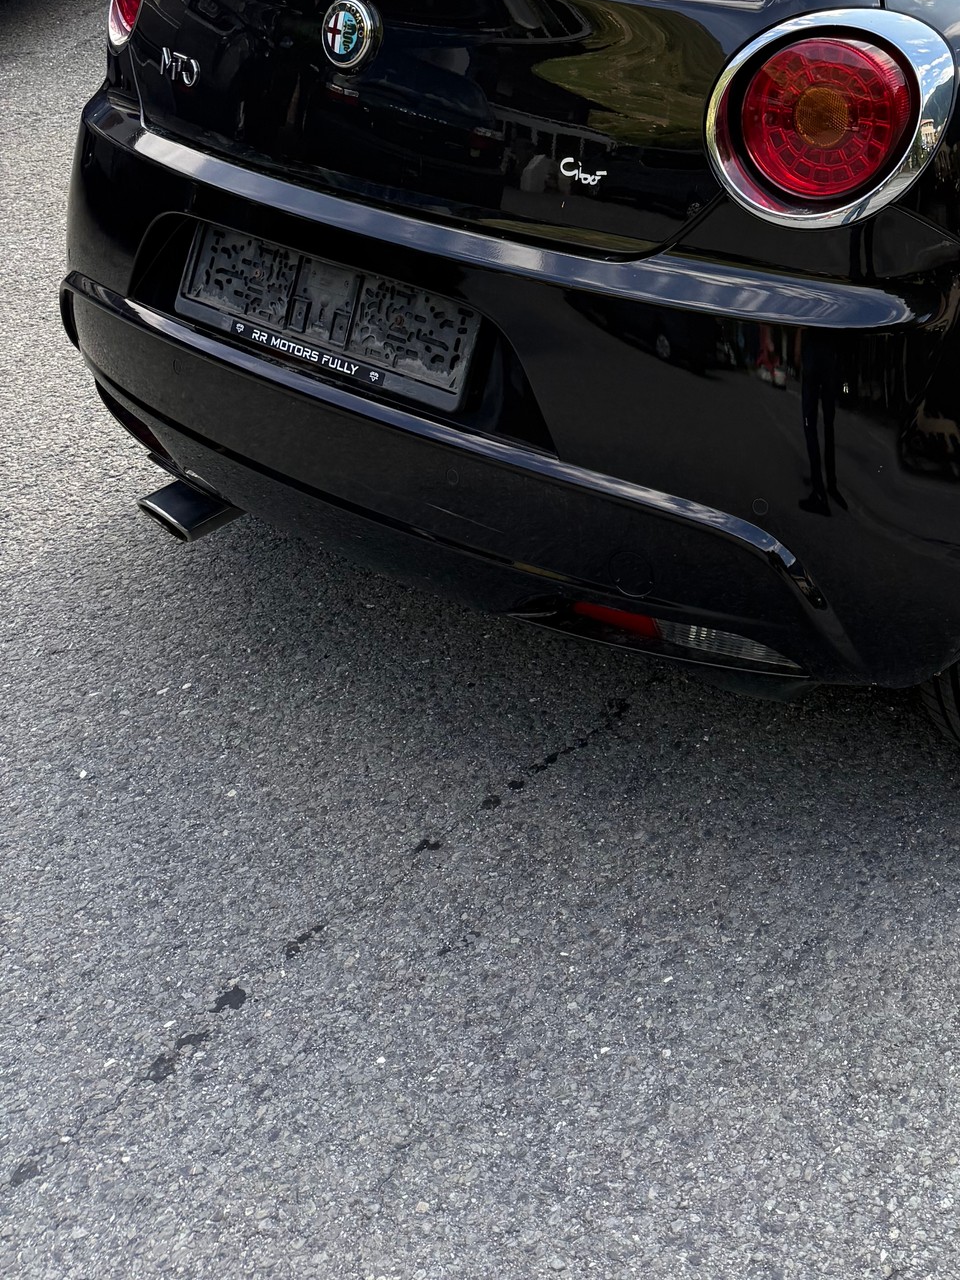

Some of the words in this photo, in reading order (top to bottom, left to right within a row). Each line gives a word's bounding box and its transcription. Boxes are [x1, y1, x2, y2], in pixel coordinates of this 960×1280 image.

[251, 329, 268, 344] RR
[270, 335, 320, 362] MOTORS
[321, 354, 359, 375] FULLY
